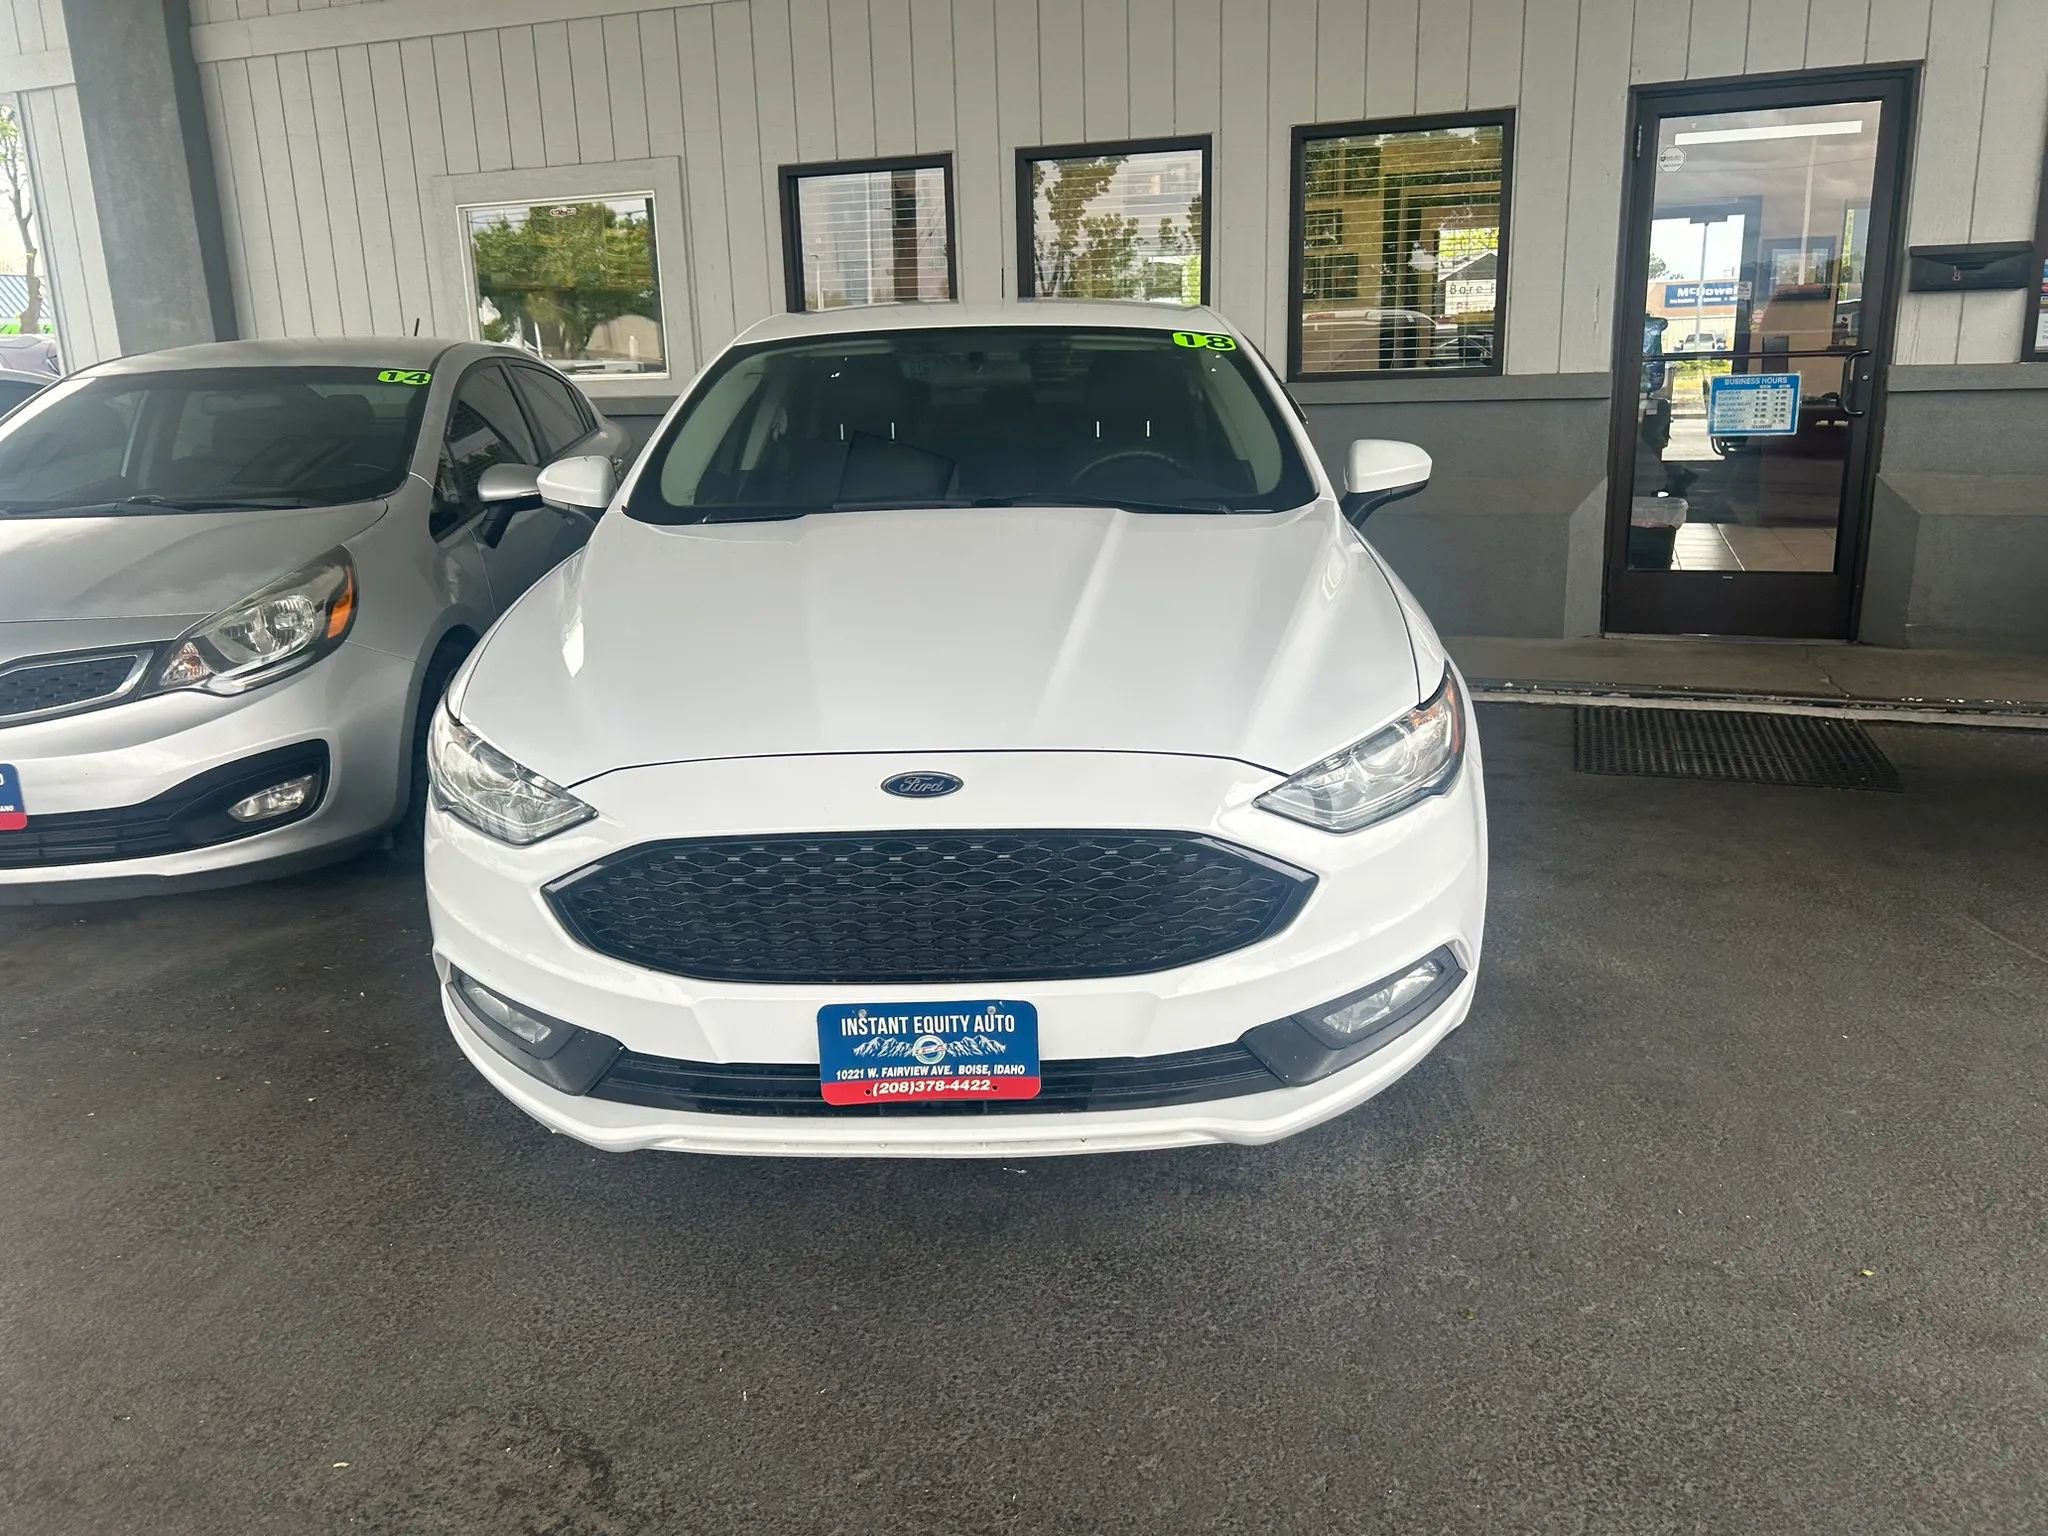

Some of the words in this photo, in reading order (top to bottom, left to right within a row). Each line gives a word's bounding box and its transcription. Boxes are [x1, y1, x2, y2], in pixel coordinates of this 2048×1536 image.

[1181, 334, 1233, 349] 18
[388, 372, 427, 384] 14
[1724, 378, 1760, 386] BUSINESS
[1761, 376, 1788, 385] HOURS
[900, 776, 944, 792] Ford
[841, 1016, 908, 1036] INSTANT
[914, 1015, 970, 1034] EQUITY
[974, 1014, 1015, 1033] AUTO
[836, 1068, 864, 1080] 10221
[867, 1067, 879, 1078] W.
[881, 1065, 929, 1078] FAIRVIEW
[930, 1065, 953, 1076] AVE.
[958, 1064, 991, 1076] BOISE,
[993, 1064, 1026, 1075] IDAHO
[872, 1080, 991, 1097] (208)378-4422
